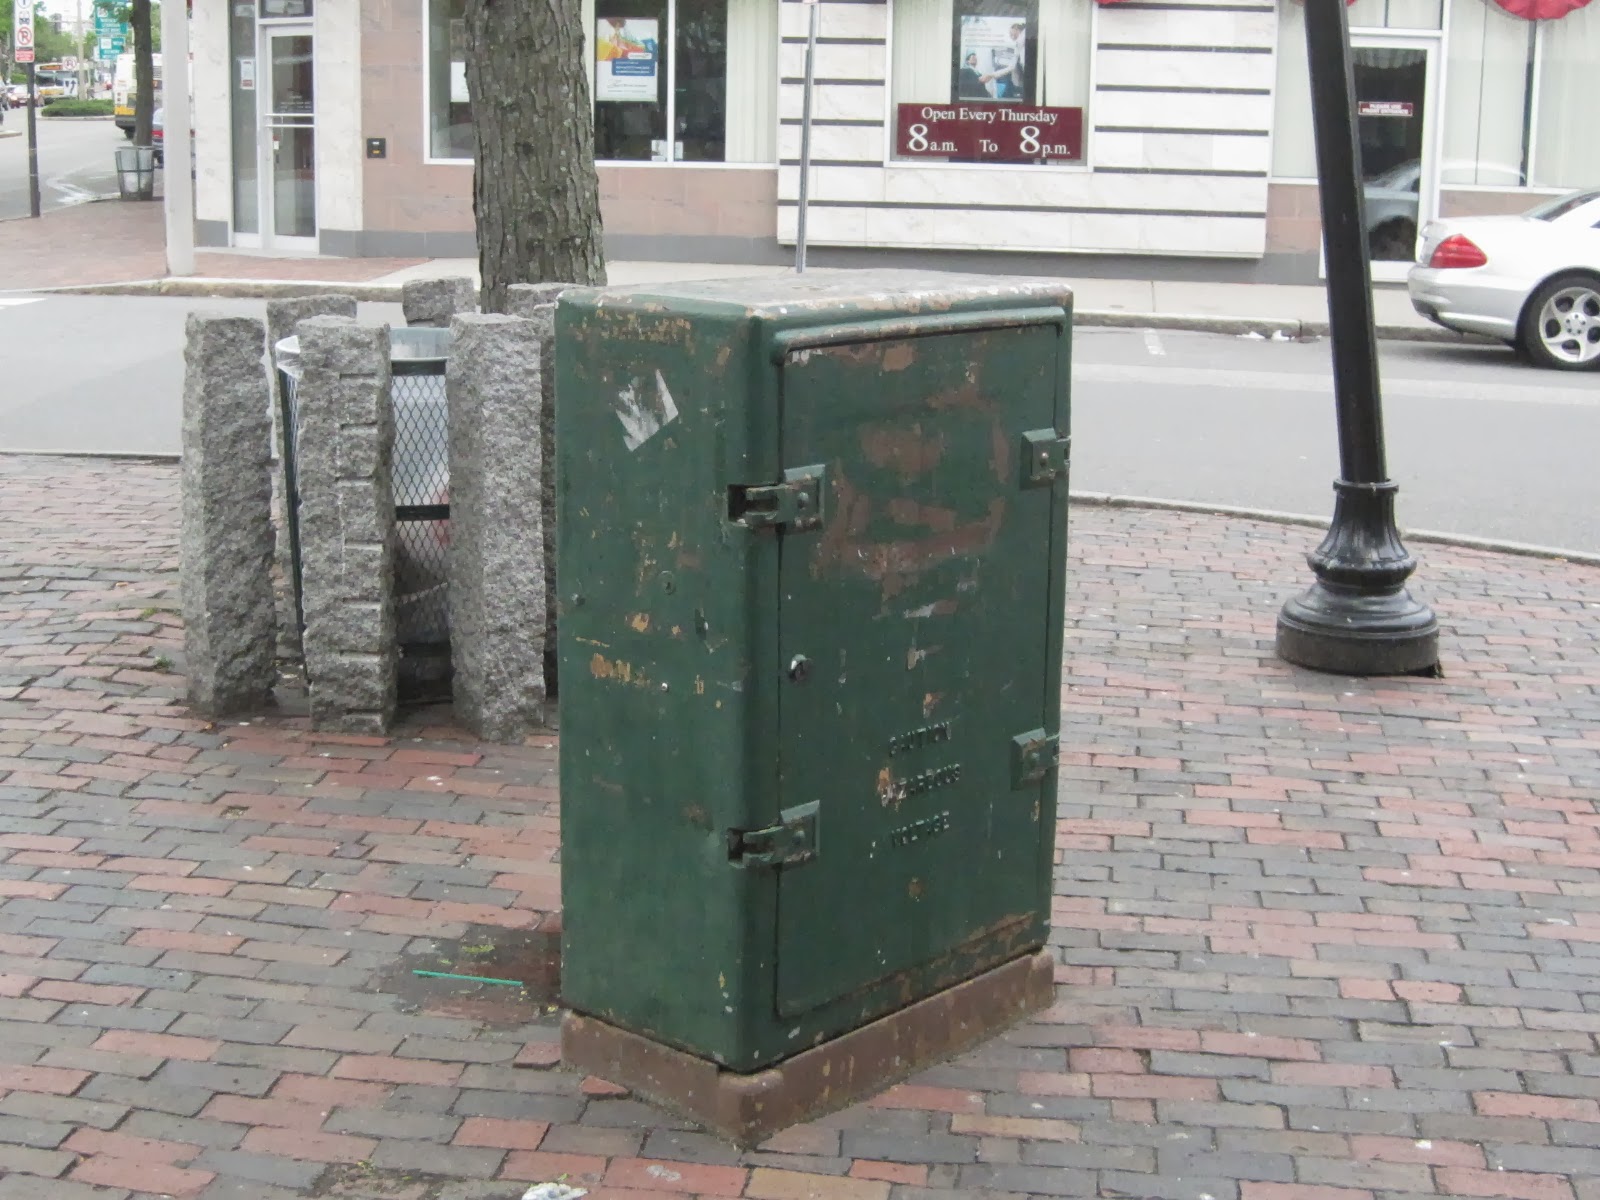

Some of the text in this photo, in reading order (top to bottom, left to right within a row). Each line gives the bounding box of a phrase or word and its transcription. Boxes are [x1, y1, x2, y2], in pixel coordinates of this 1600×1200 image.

[921, 107, 1058, 125] Open Every Thursday
[979, 139, 998, 153] To
